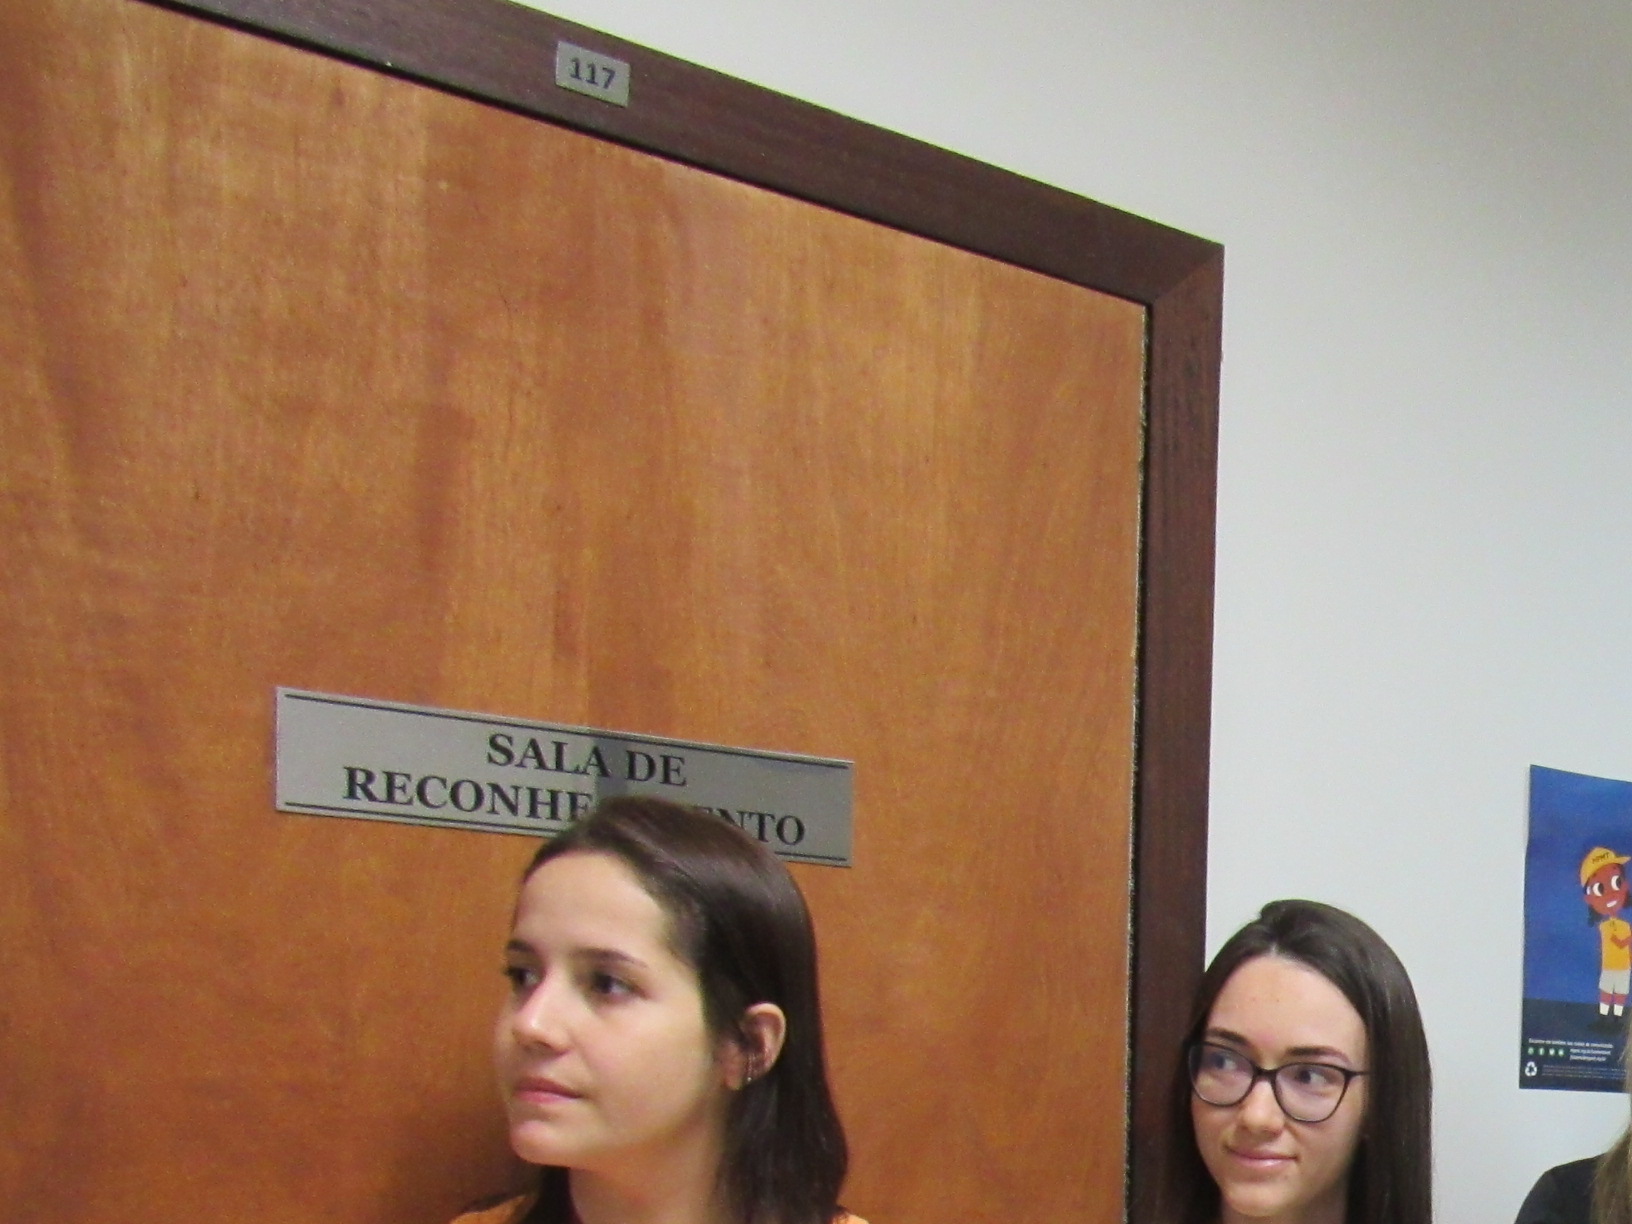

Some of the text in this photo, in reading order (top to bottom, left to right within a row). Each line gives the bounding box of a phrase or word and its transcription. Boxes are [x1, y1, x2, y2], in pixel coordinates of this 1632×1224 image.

[569, 56, 617, 90] 117
[486, 732, 688, 788] SALA DE
[342, 765, 806, 847] RECONHENTO
